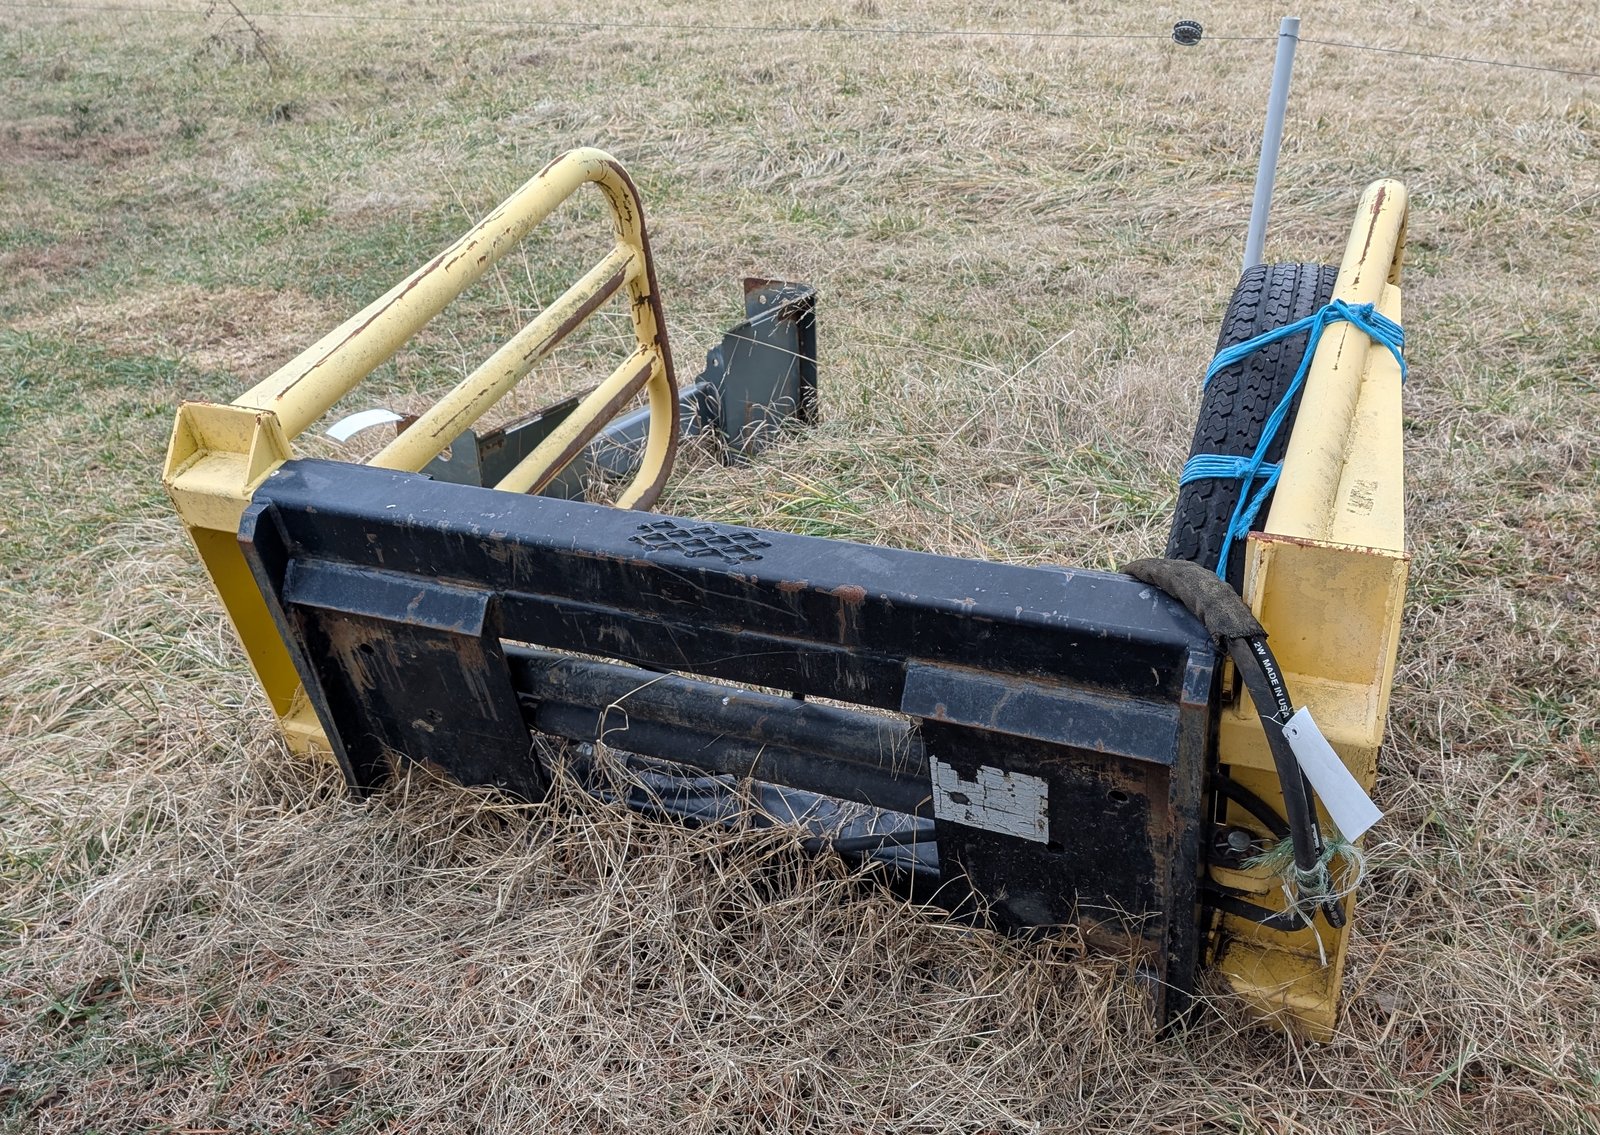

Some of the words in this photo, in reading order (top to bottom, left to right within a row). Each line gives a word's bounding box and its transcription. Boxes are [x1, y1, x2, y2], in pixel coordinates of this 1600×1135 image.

[1253, 641, 1266, 655] 2W
[1262, 658, 1279, 686] MADE
[1274, 686, 1284, 697] IN
[1278, 698, 1290, 719] USA
